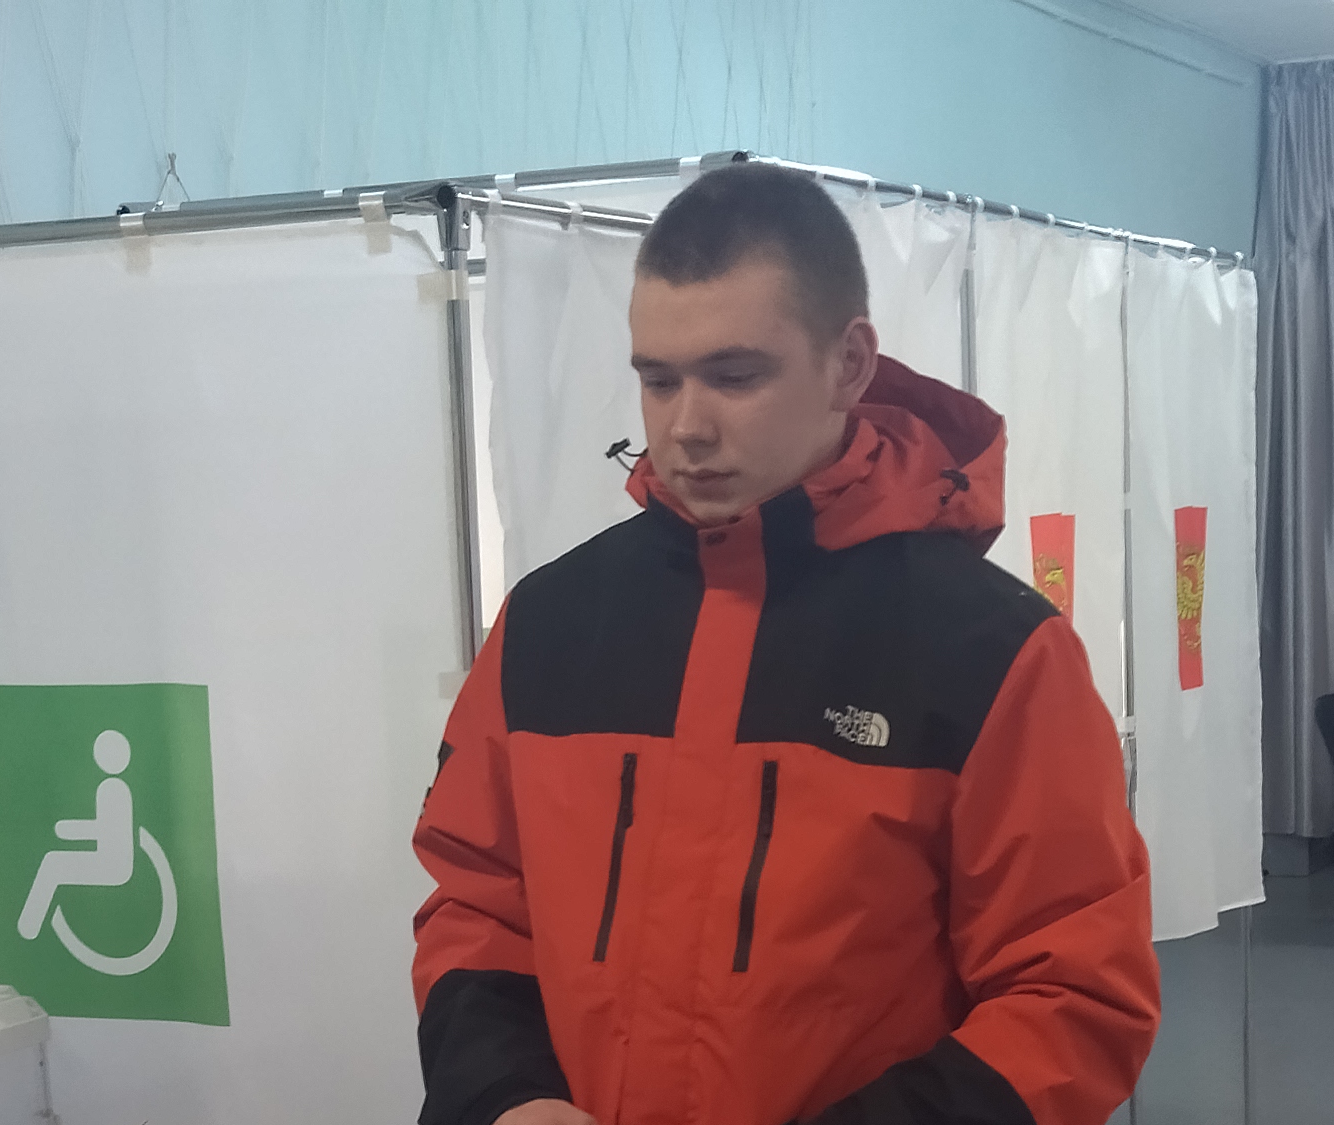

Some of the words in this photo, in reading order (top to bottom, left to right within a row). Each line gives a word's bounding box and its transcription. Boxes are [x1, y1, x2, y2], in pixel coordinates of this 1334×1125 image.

[823, 707, 872, 735] NORTH
[846, 705, 873, 722] THE
[833, 723, 868, 745] FACE
